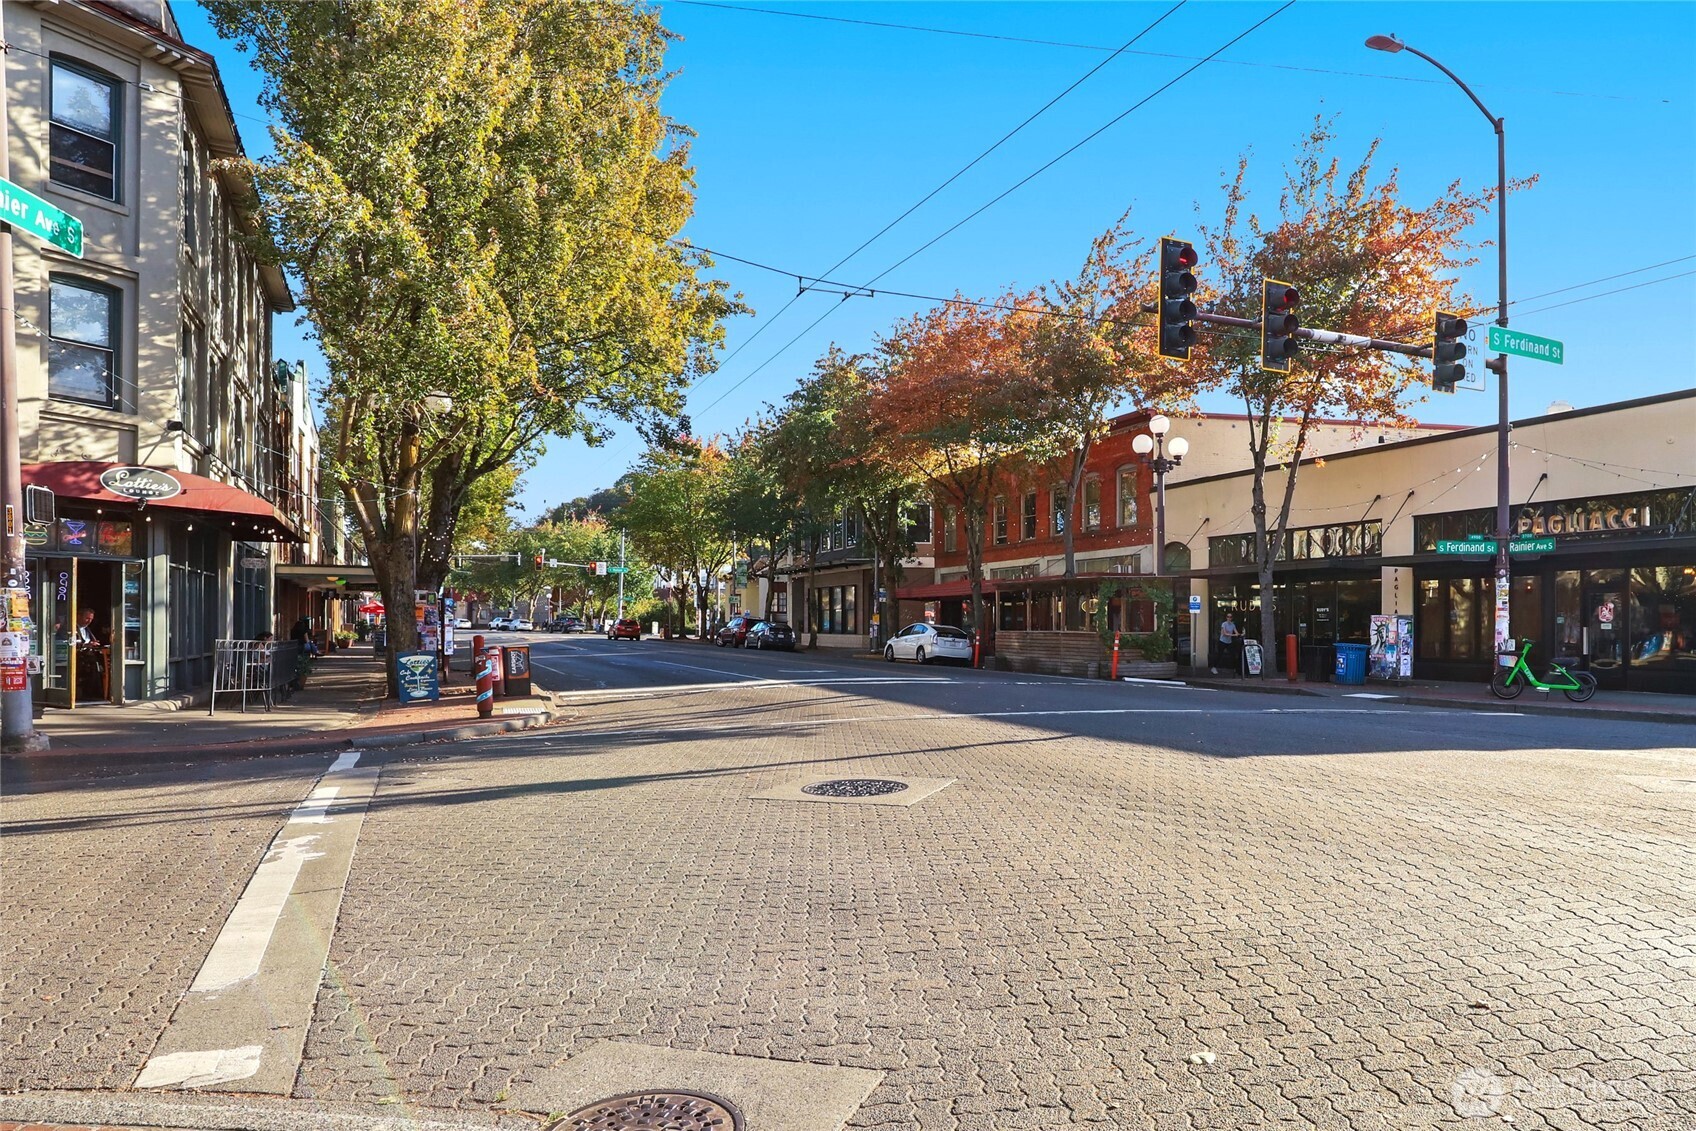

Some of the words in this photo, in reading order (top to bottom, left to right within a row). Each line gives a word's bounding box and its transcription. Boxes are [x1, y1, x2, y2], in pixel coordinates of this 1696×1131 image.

[34, 209, 60, 236] Ave
[67, 226, 75, 244] S
[1493, 332, 1500, 346] S
[1504, 334, 1549, 356] Ferdinand
[1552, 346, 1561, 359] St
[1465, 372, 1475, 383] ED
[108, 470, 173, 491] Lottie's
[1517, 507, 1650, 535] PAGLIACCI
[1446, 542, 1485, 552] Ferdinand
[1509, 541, 1535, 552] Rainier
[1548, 542, 1553, 550] S
[1231, 596, 1277, 611] RUDS
